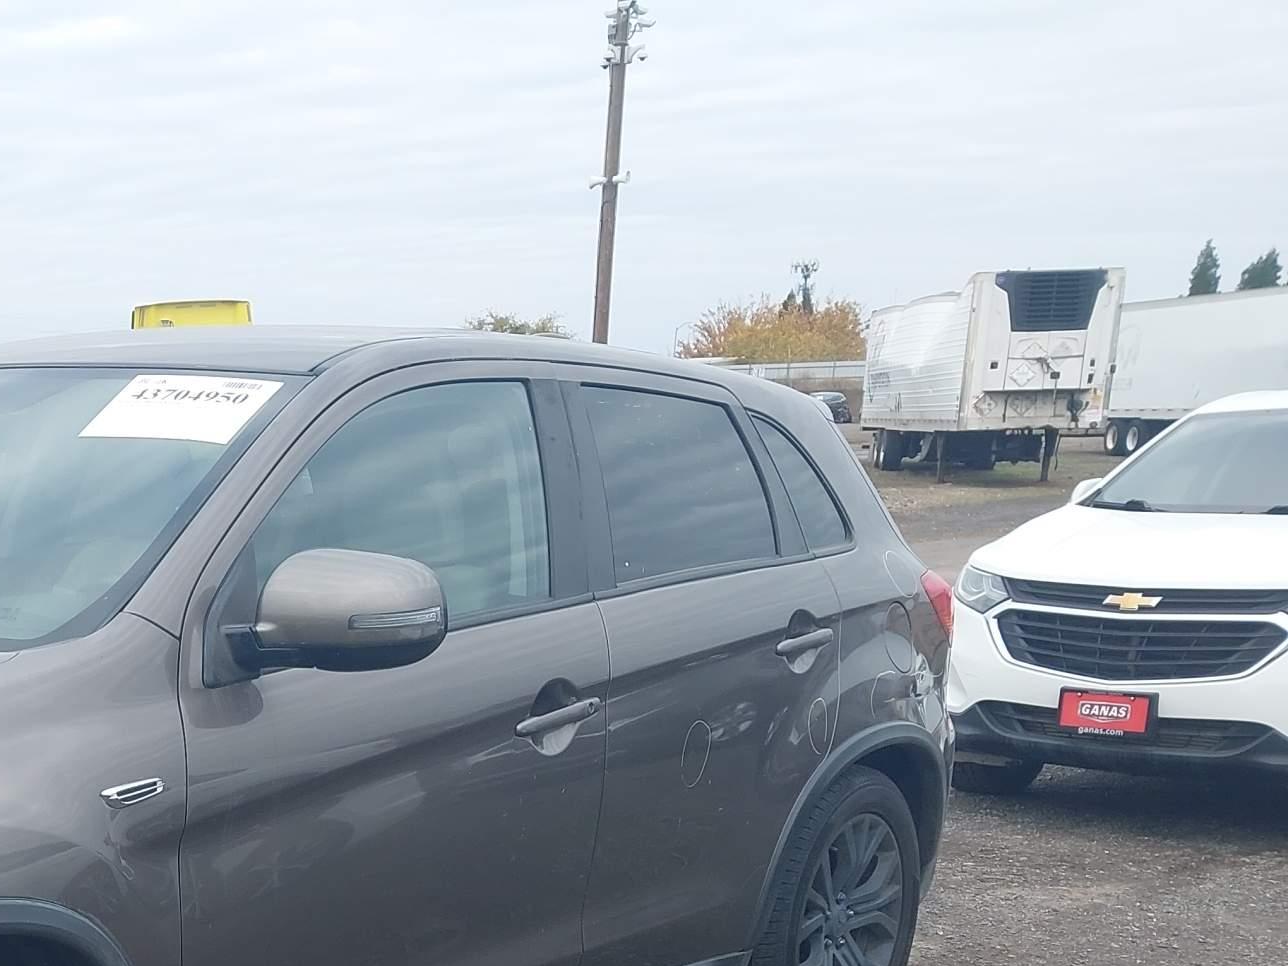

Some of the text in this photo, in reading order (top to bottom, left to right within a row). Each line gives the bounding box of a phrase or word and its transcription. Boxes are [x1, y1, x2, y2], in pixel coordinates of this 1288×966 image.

[132, 388, 249, 404] 43704950
[1082, 705, 1127, 717] GANAS
[1078, 727, 1124, 736] ganas.com
